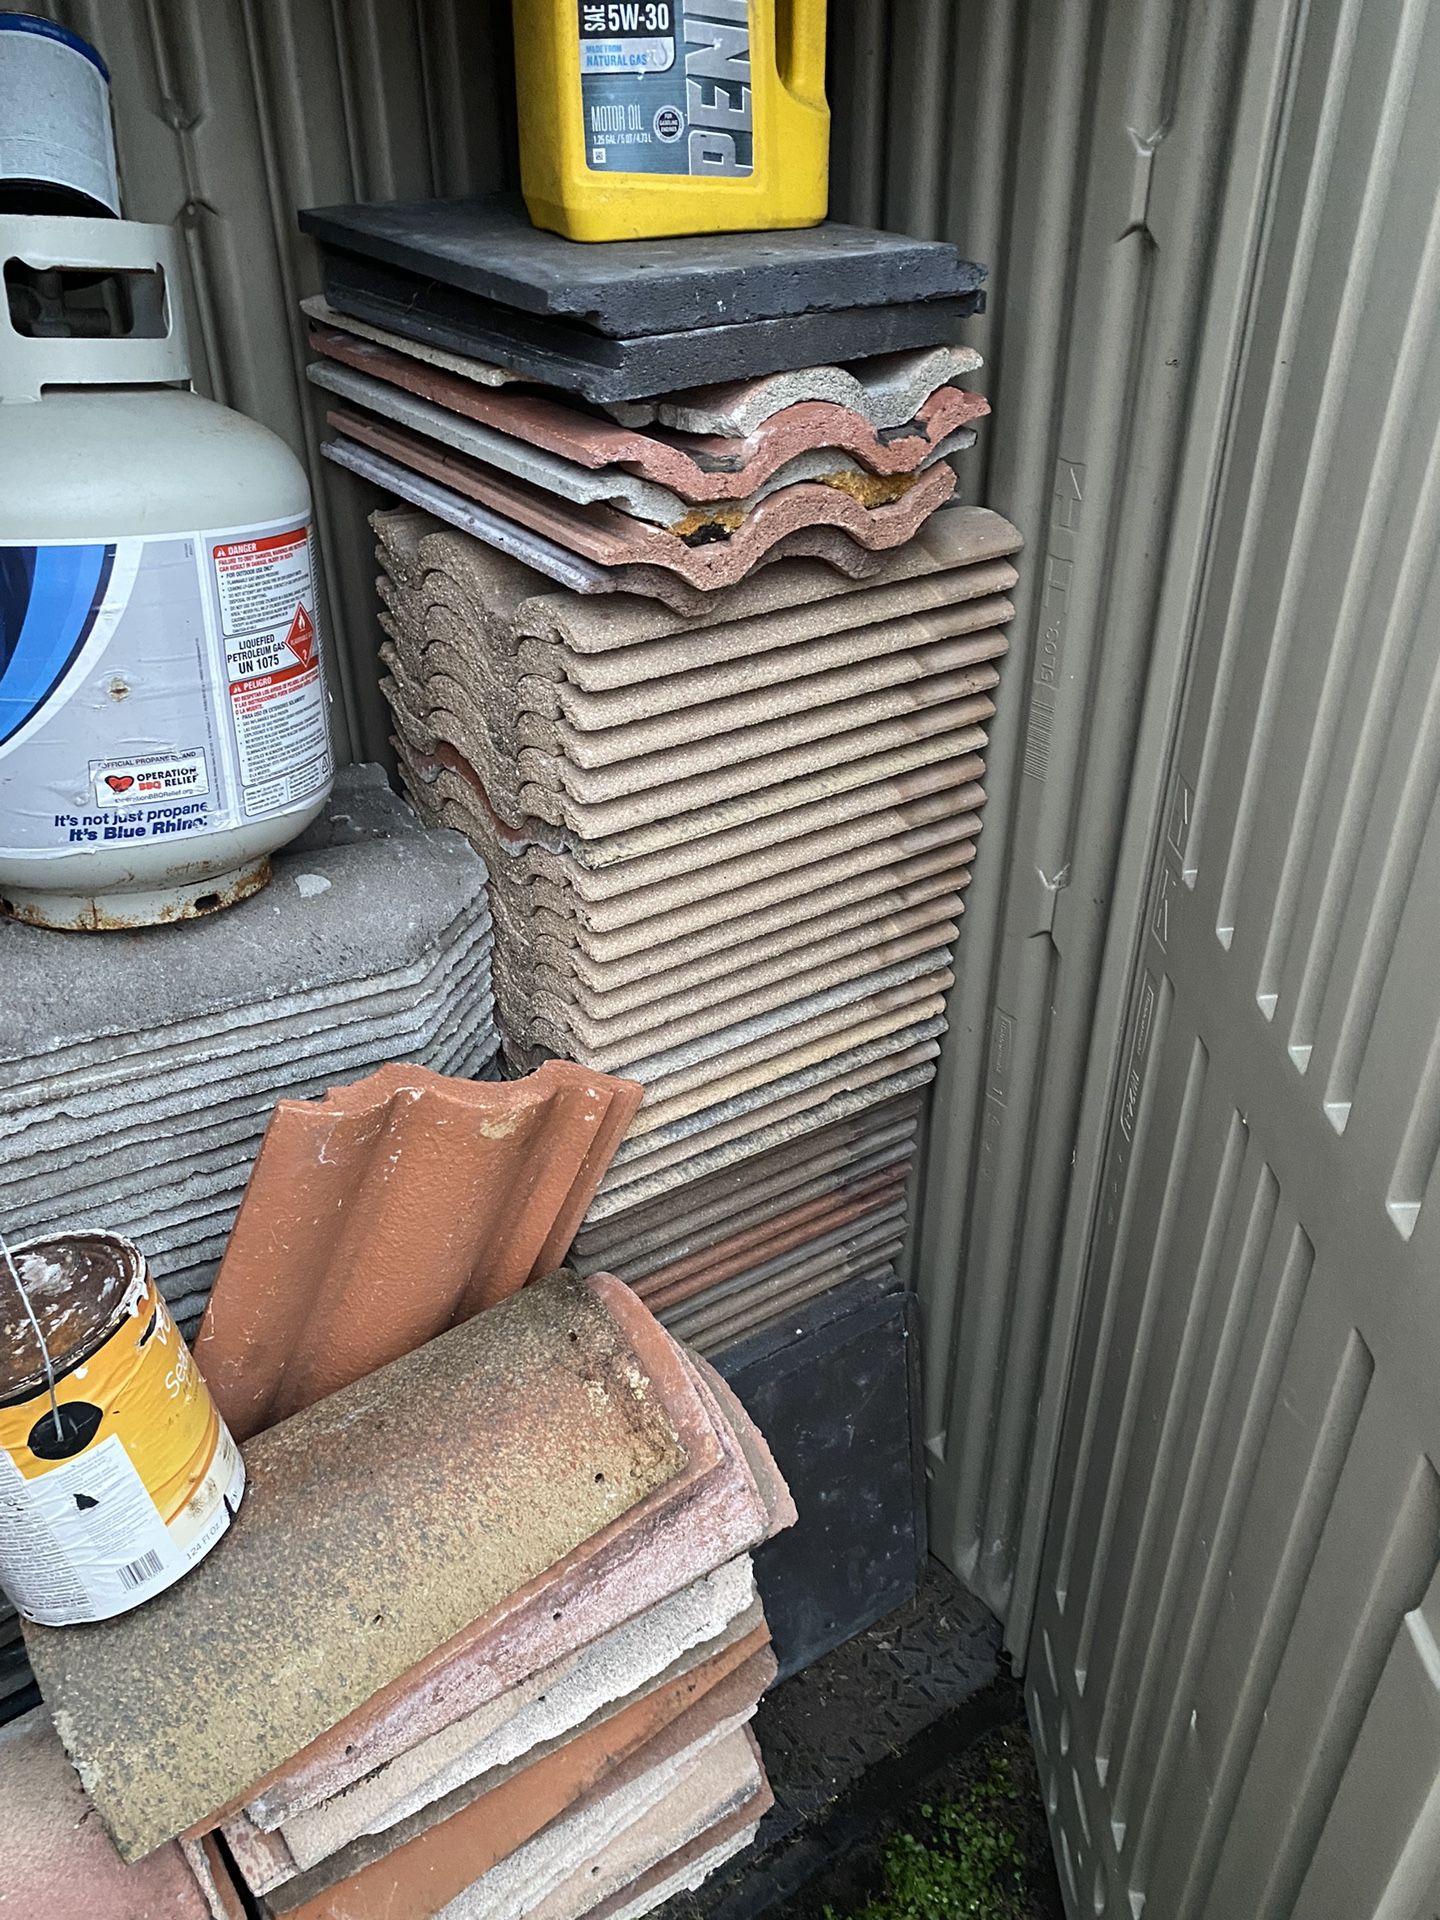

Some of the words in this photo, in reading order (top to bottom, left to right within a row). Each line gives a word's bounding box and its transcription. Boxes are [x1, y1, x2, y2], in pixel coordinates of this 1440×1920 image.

[584, 4, 606, 30] SAE
[608, 3, 669, 30] 5W-30
[587, 55, 628, 66] NATURAL
[630, 54, 647, 66] GAS
[591, 105, 626, 132] MOTOR
[628, 104, 644, 130] OIL
[228, 543, 256, 555] DANGER
[239, 634, 275, 650] LIQUEFIED
[227, 645, 271, 663] PETROLEUM
[273, 641, 285, 652] GAS
[239, 662, 254, 674] UN
[257, 654, 279, 670] 1075
[244, 677, 272, 690] PELIGRO
[135, 755, 169, 765] PROPANE
[137, 768, 197, 782] OPERATION
[139, 782, 161, 791] BBQ
[165, 775, 199, 787] RELIEF
[54, 815, 78, 826] It's
[82, 813, 109, 826] not
[112, 810, 143, 825] just
[147, 802, 208, 823] propane
[69, 828, 98, 842] It's
[104, 826, 146, 840] Blue
[186, 1543, 202, 1560] 124
